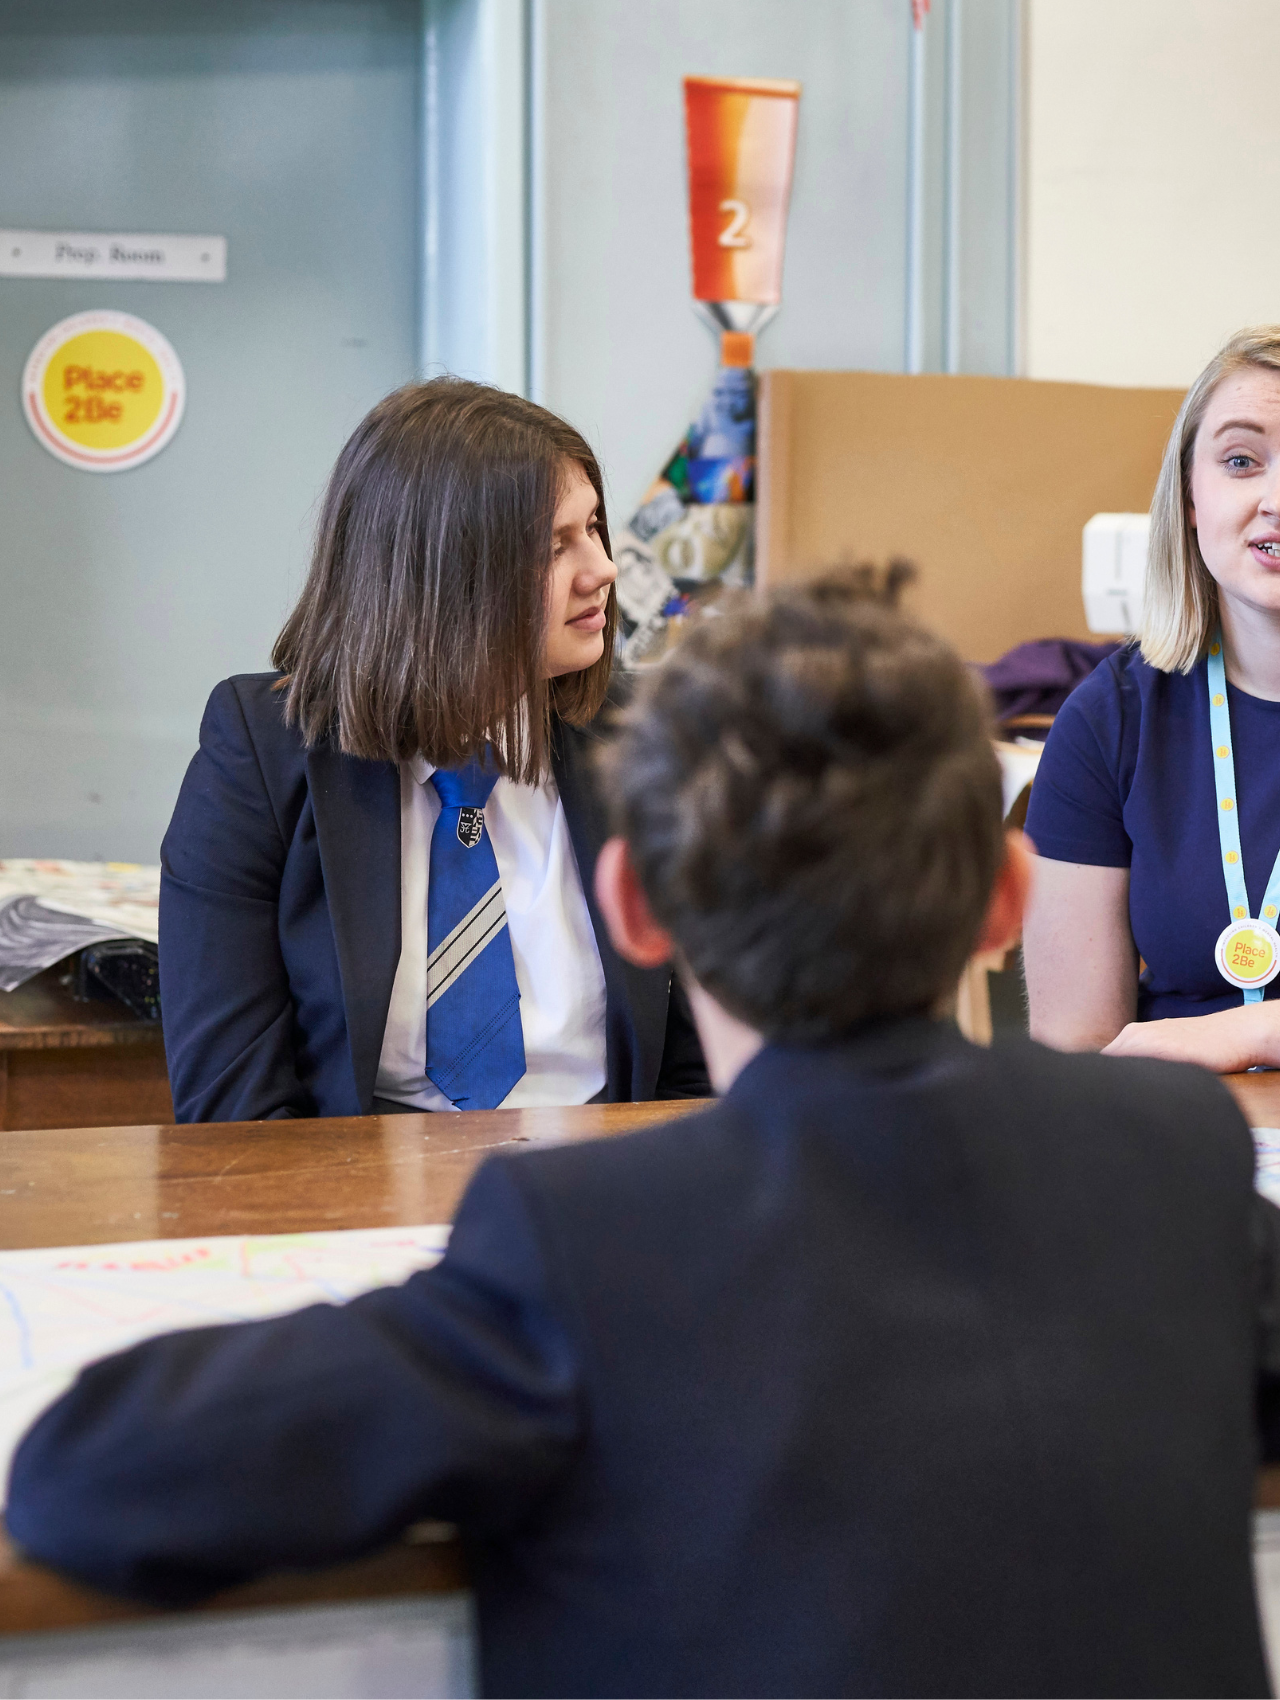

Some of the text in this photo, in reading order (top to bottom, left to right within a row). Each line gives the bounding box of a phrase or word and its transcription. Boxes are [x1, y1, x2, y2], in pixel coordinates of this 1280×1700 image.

[718, 199, 751, 248] 2
[63, 364, 145, 393] Place
[64, 396, 123, 424] 2Be
[1232, 954, 1255, 968] 2Be
[1234, 942, 1266, 958] Place
